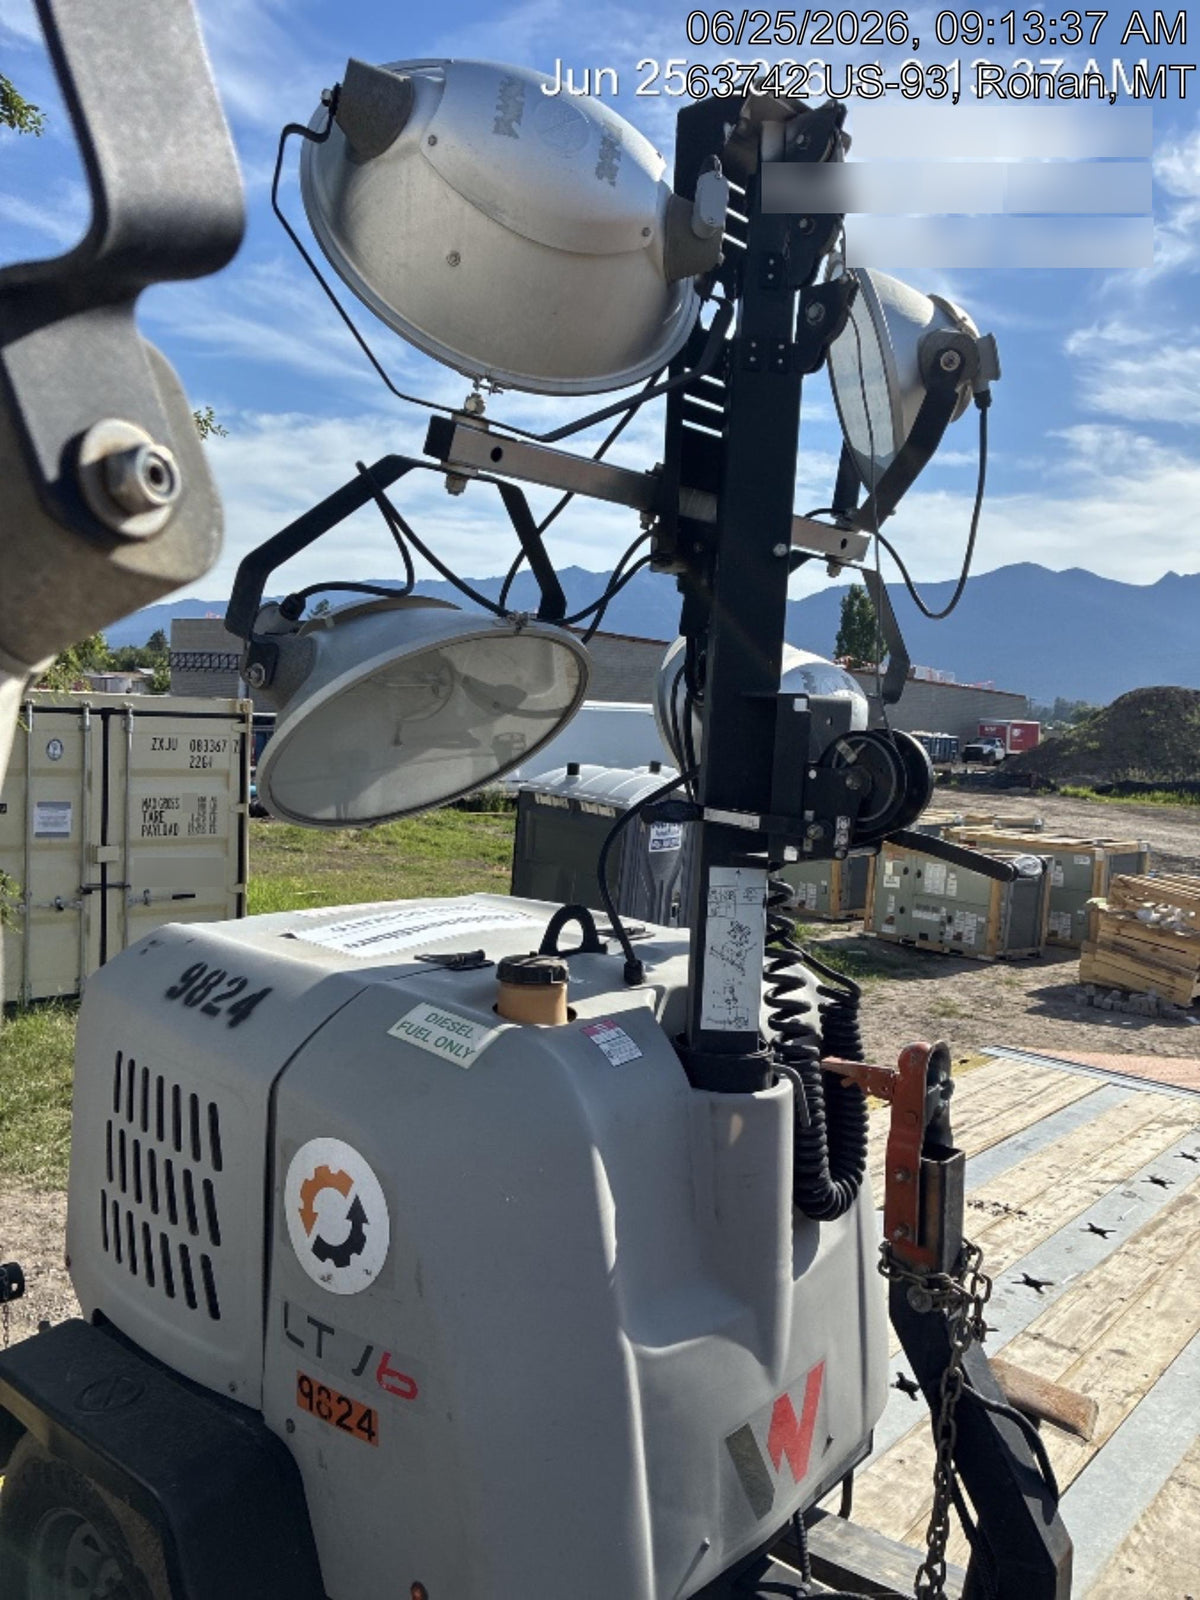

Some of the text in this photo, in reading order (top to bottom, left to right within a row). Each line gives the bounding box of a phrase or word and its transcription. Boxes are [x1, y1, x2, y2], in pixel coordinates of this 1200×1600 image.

[165, 961, 273, 1029] 9824
[396, 1021, 475, 1059] FUEL ONLY
[425, 1013, 473, 1038] DIESEL
[298, 1374, 376, 1442] 9824
